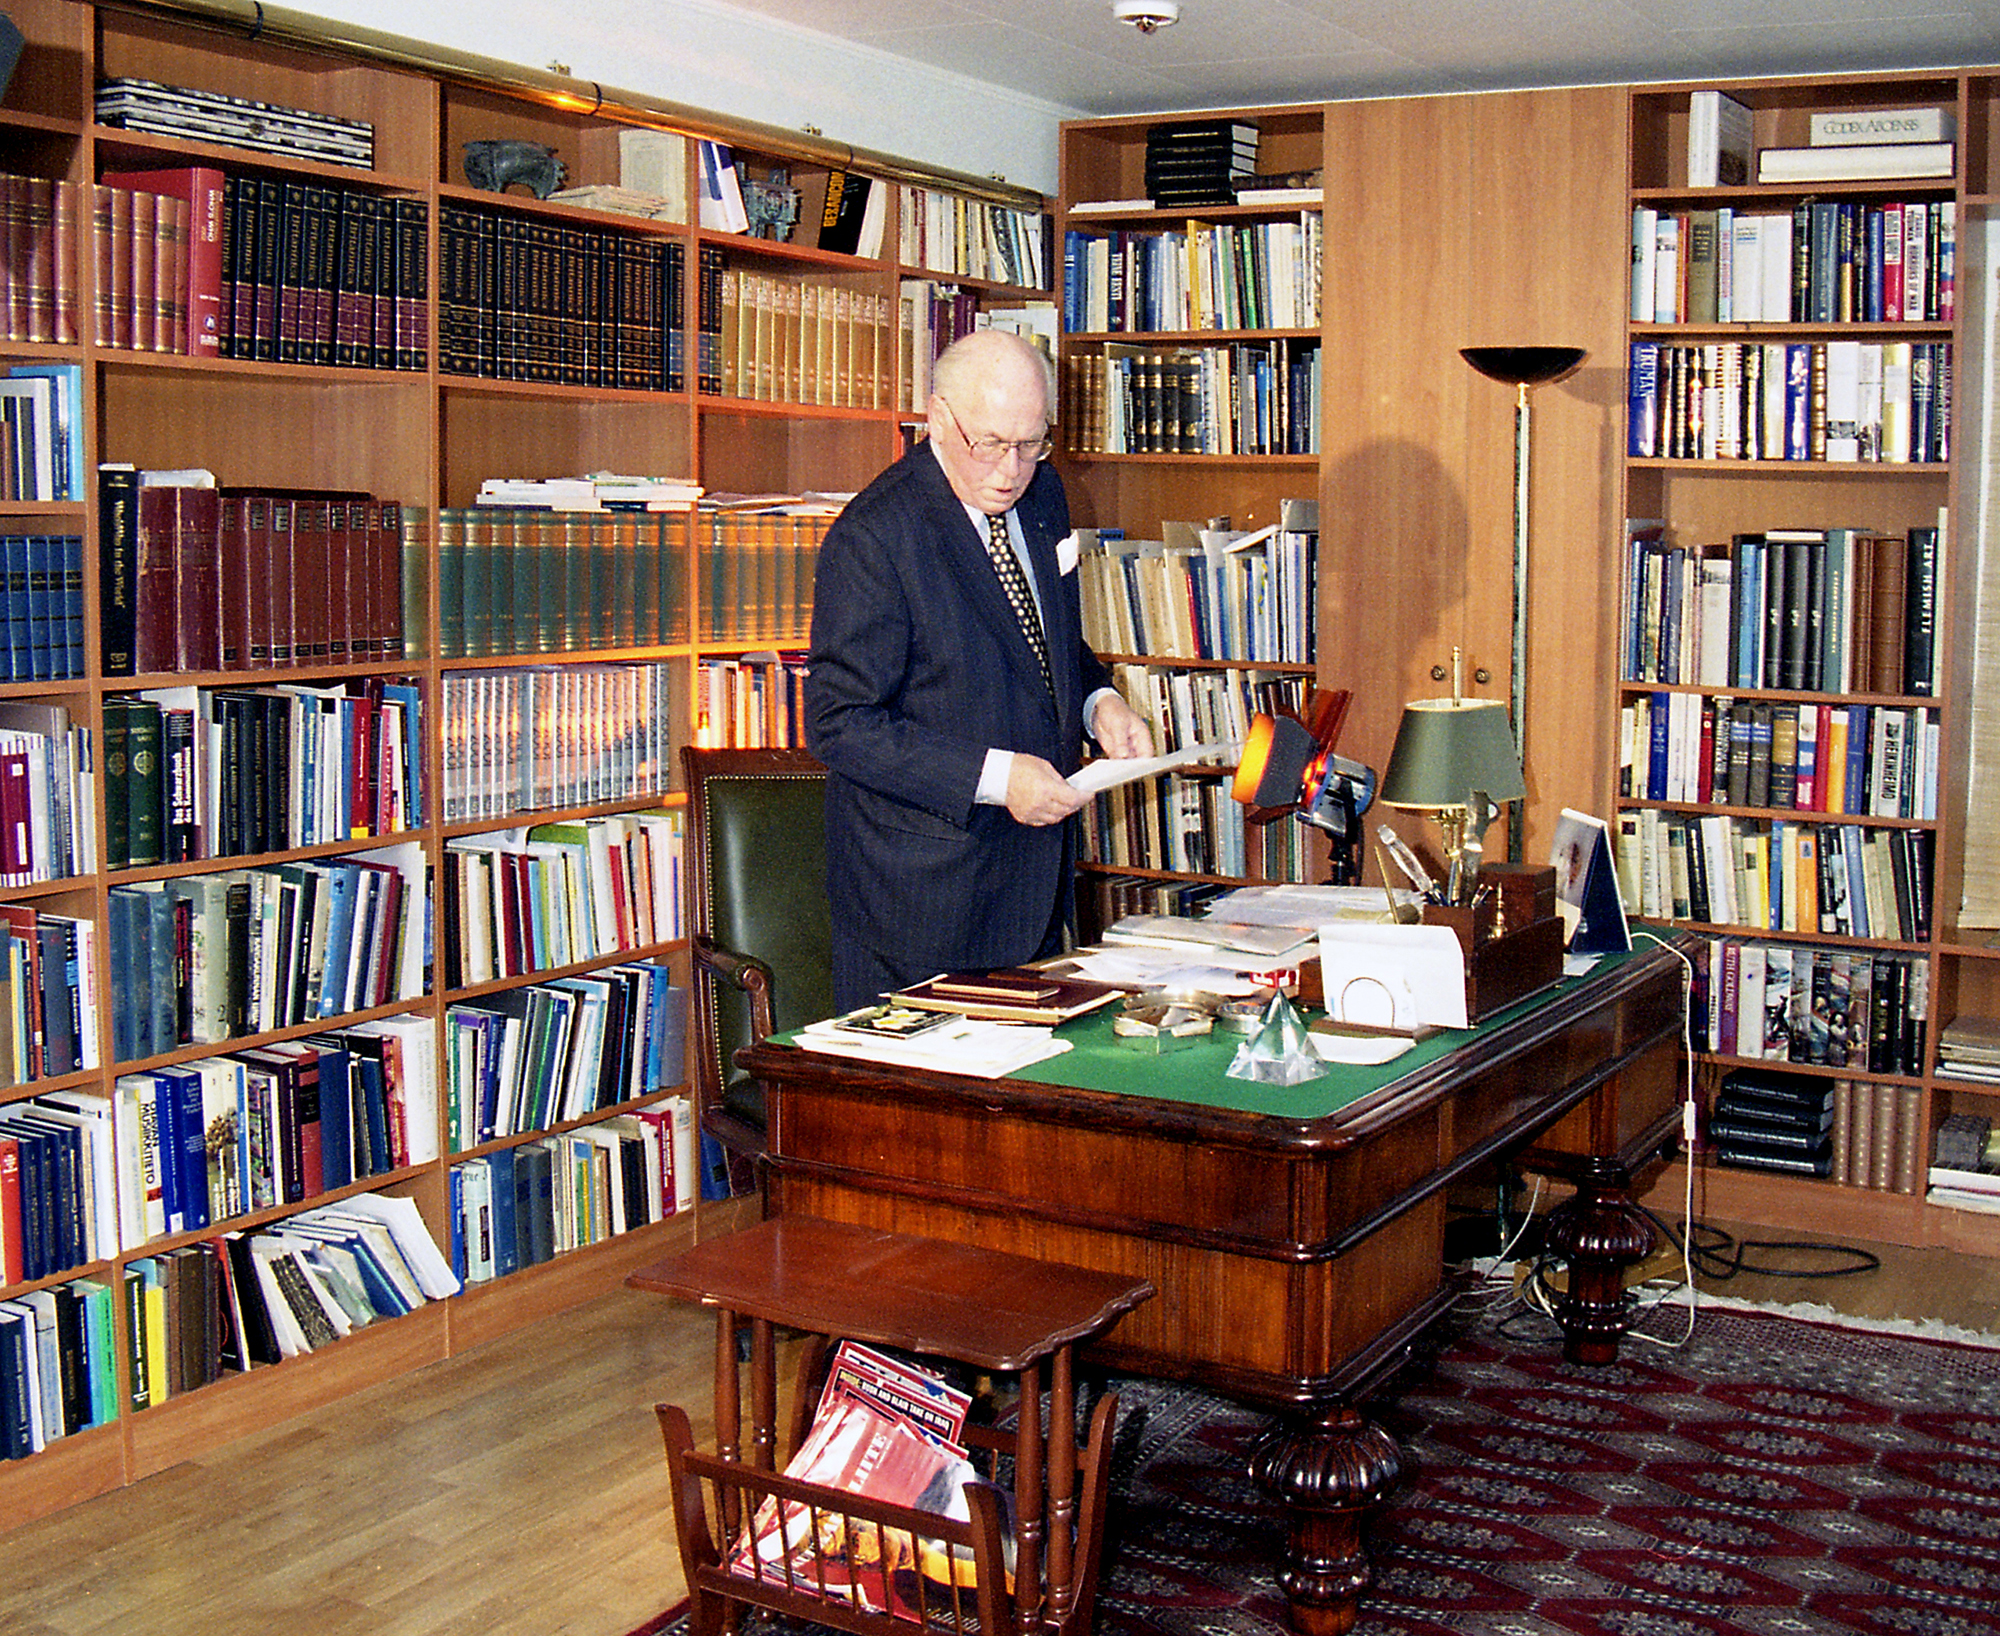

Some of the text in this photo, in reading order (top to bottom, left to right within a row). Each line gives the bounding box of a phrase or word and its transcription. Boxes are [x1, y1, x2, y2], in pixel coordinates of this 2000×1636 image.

[1823, 121, 1866, 135] CODEX
[222, 207, 232, 273] Britannica
[245, 209, 255, 275] Britannica
[266, 212, 276, 278] Britannica
[290, 214, 300, 279] Britannica
[309, 216, 319, 281] Britannica
[325, 218, 336, 283] Britannica
[347, 220, 358, 285] Britannica
[364, 223, 375, 286] Britannica
[383, 226, 391, 289] Britannica
[403, 228, 412, 291] Britannica
[418, 230, 427, 293] Britannica
[1909, 295, 1918, 311] WAR
[1640, 345, 1658, 398] TRUMAN
[114, 560, 124, 575] the
[1921, 544, 1934, 634] FLEMISH ART
[172, 752, 183, 825] Das Schwarzbuch
[1882, 740, 1899, 799] HEIKINHEIMO
[140, 1102, 155, 1185] MUSIIKKITIETO
[149, 1100, 159, 1148] OTAVAN
[862, 1380, 878, 1396] BUSH
[878, 1389, 891, 1402] AND
[891, 1395, 909, 1411] BLAIR
[909, 1403, 925, 1417] TAKE
[924, 1411, 935, 1422] ON
[934, 1415, 950, 1431] IRAQ
